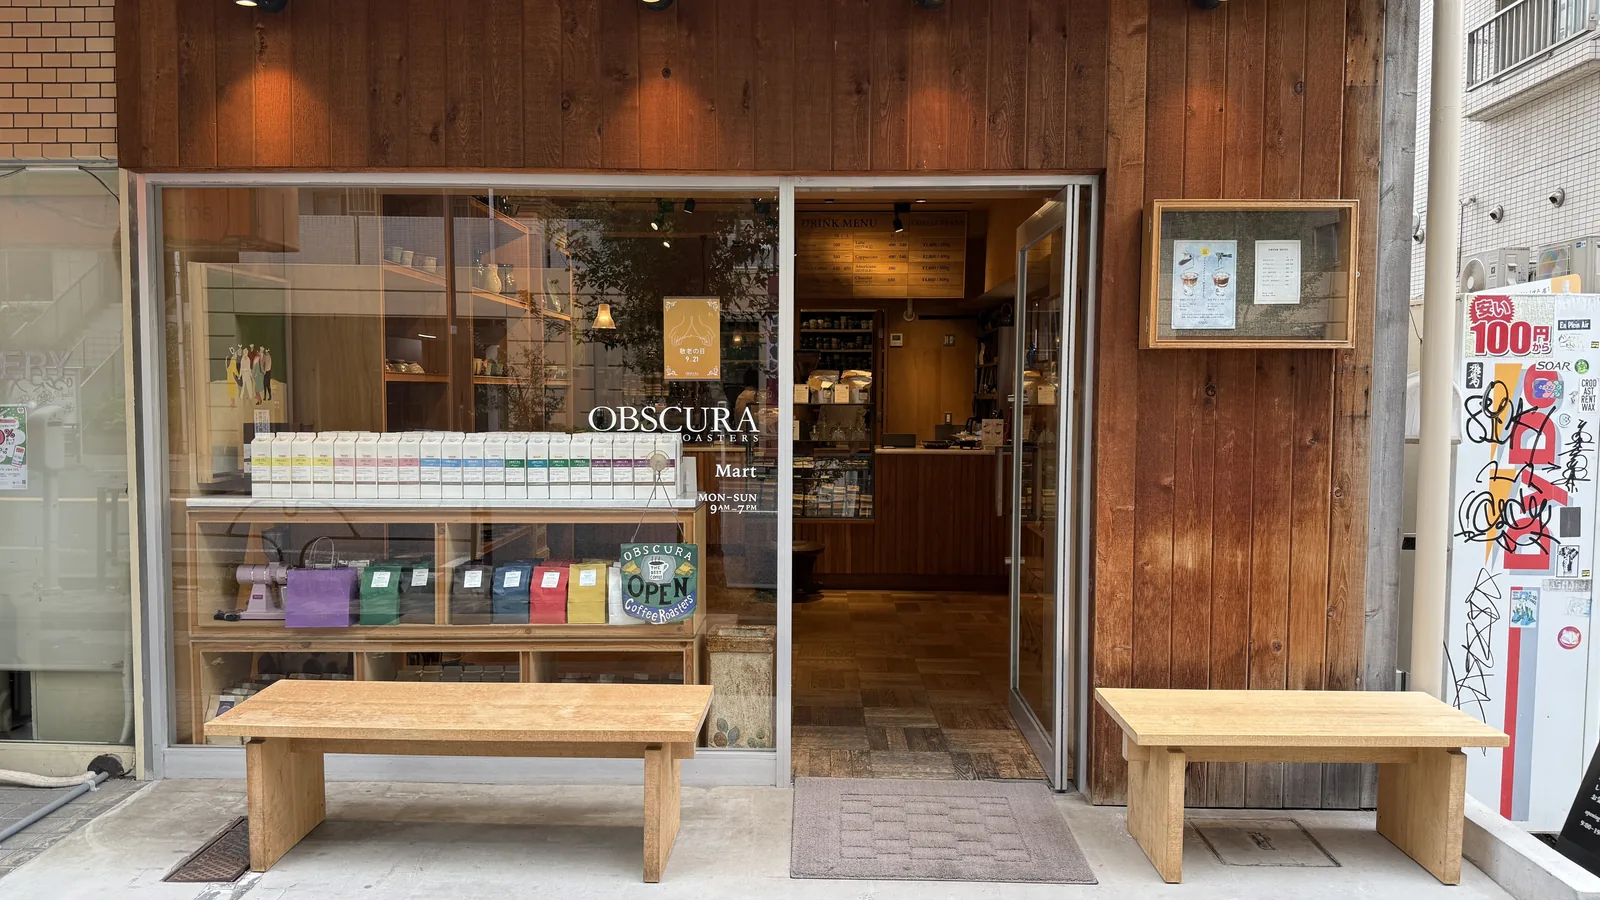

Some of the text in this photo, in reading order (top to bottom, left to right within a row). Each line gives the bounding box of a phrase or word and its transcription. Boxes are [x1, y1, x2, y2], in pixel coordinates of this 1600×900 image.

[802, 219, 878, 227] DRINK MENU
[1475, 299, 1511, 318] 安い
[679, 347, 705, 355] 敬老の日
[1536, 361, 1571, 371] SOAR
[1583, 387, 1594, 395] AST
[1581, 395, 1596, 404] RENT
[1581, 403, 1596, 412] WAX
[588, 405, 760, 433] OBSCURA
[715, 463, 757, 478] Mart
[698, 493, 758, 502] MON-SUN
[623, 544, 692, 561] OBSCURA
[627, 574, 689, 606] OPEN
[624, 595, 694, 623] Coffee Roasters
